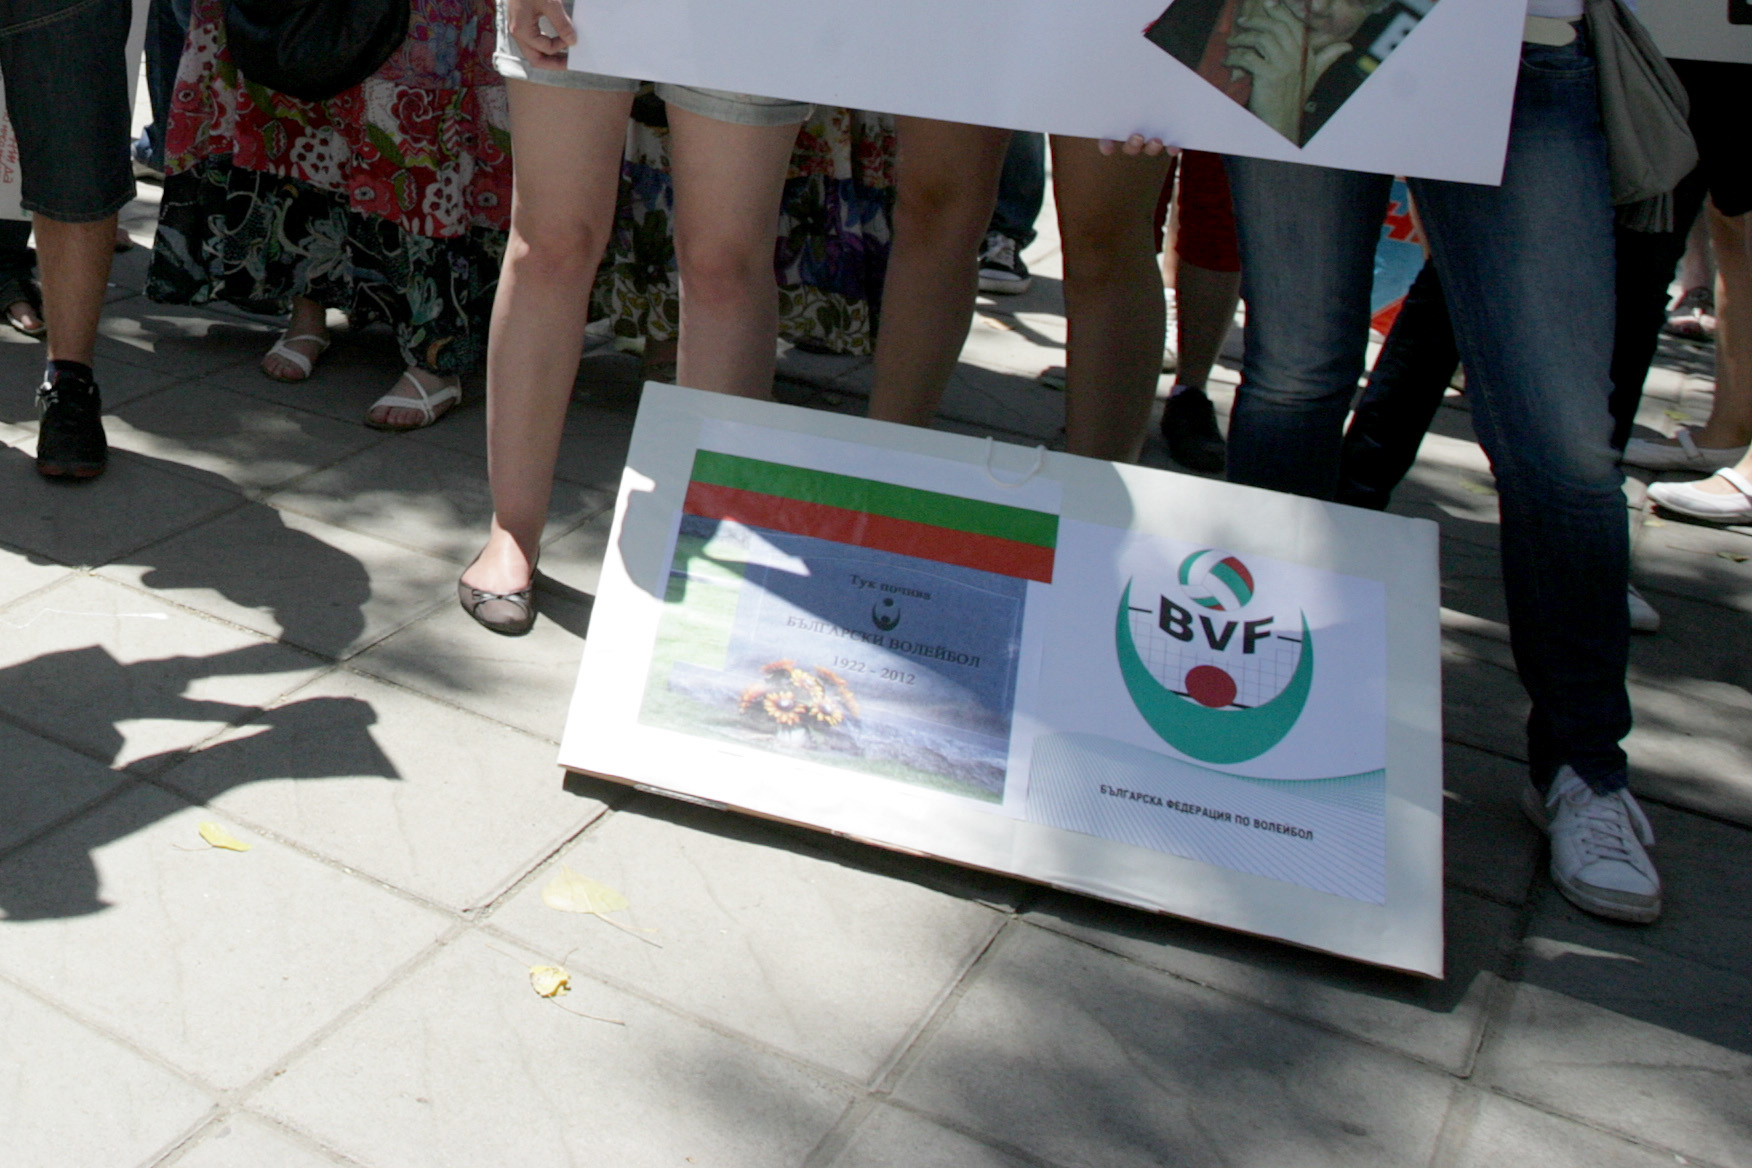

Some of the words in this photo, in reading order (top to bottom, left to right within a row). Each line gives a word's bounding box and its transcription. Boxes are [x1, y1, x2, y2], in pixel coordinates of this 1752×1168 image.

[850, 574, 877, 590] Тук
[786, 615, 885, 647] БЪЛГАРСКИ
[888, 637, 982, 669] ВОЛЕЙБОЛ
[1159, 593, 1275, 655] BVF
[833, 655, 867, 674] 1922
[880, 666, 916, 686] 2012
[1099, 784, 1164, 808] БЪЛГАРСКА
[1166, 799, 1232, 823] ФЕДЕРАЦИЯ
[1234, 814, 1250, 827] ПО
[1253, 818, 1314, 841] ВОЛЕЙБОЛ
